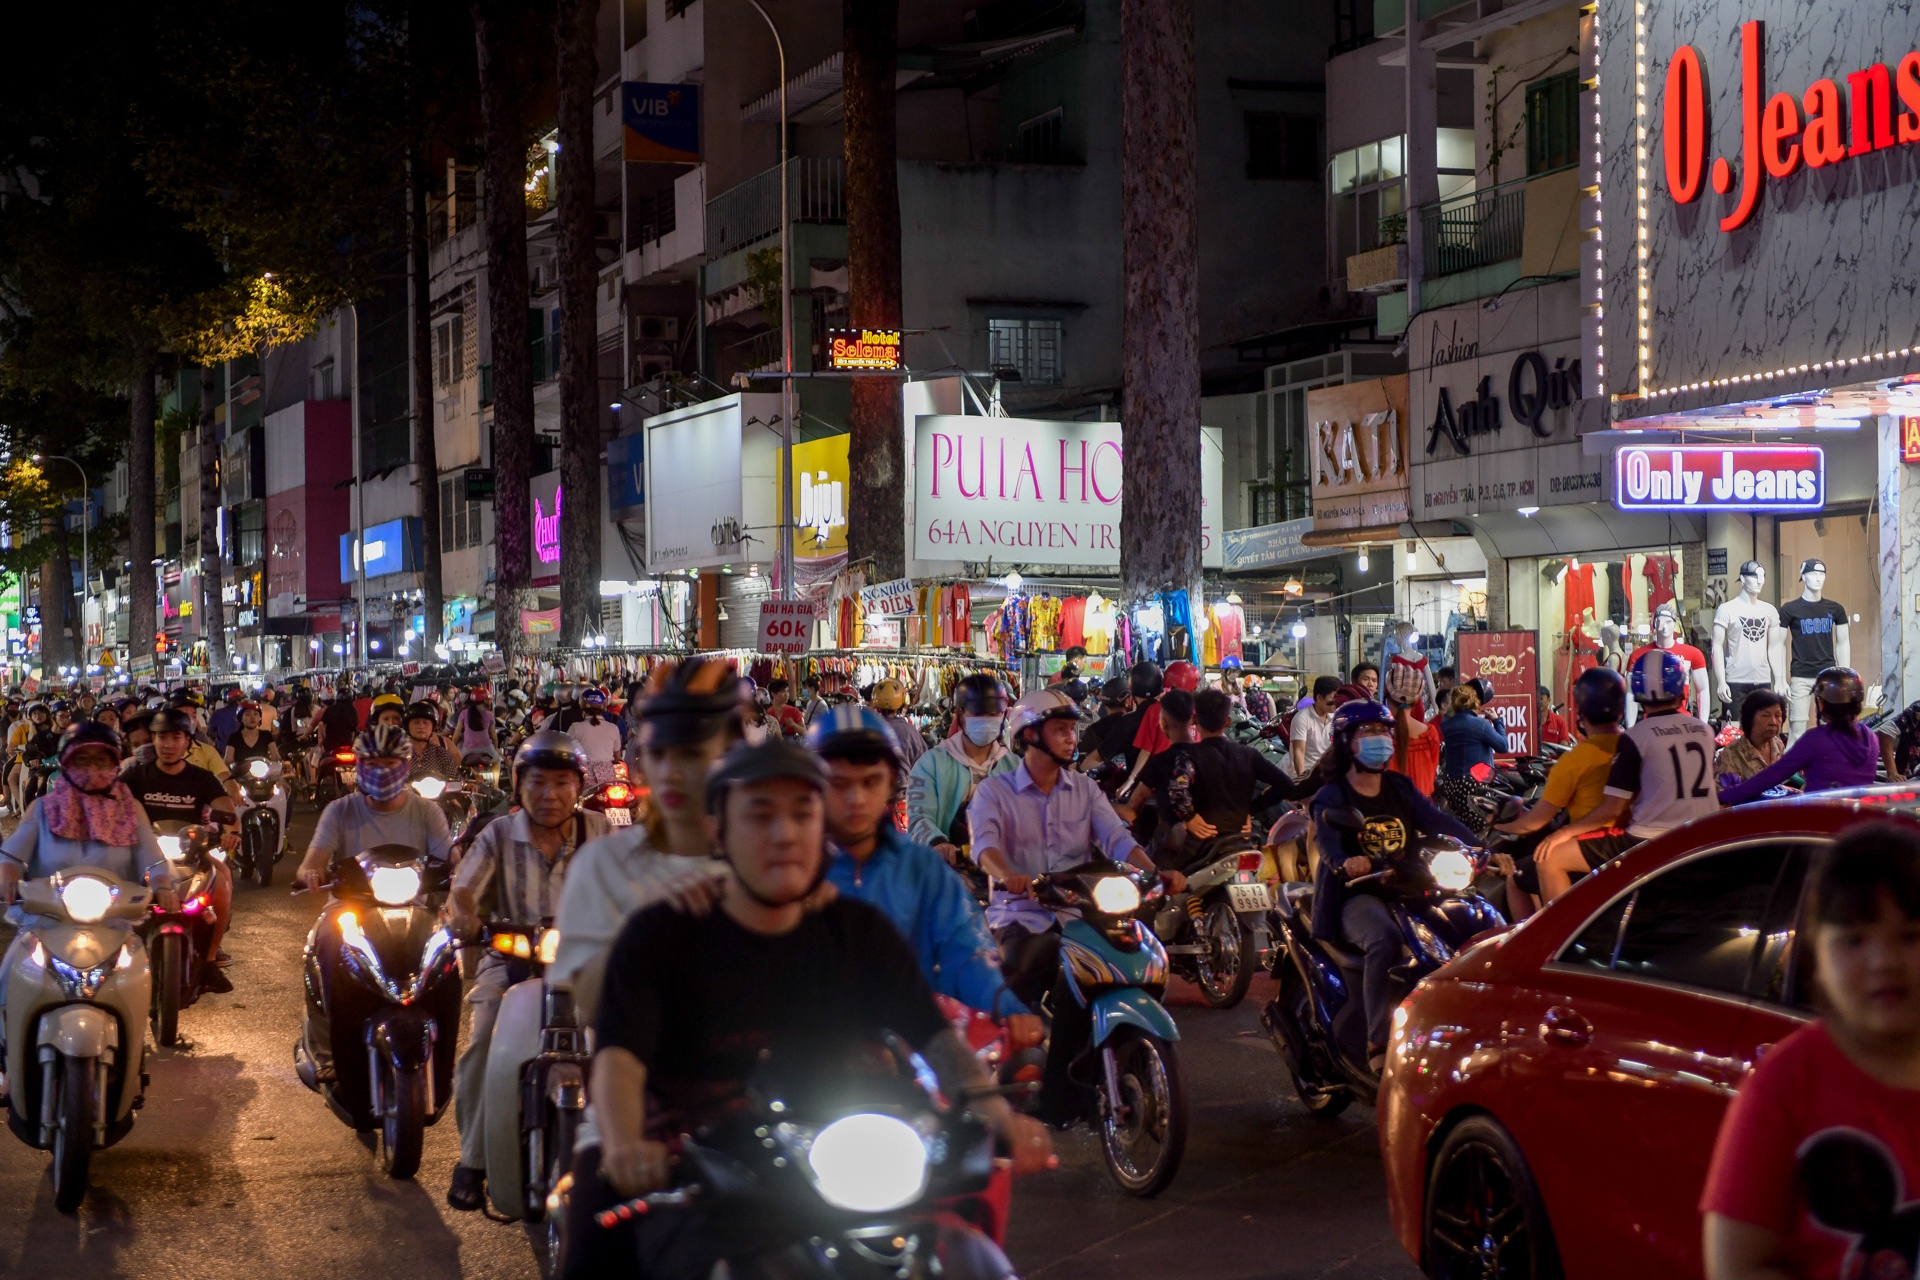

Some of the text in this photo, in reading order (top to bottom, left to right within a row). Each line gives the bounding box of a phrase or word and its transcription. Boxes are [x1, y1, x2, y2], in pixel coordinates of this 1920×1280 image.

[632, 97, 669, 116] VIB
[833, 338, 896, 358] Selena
[862, 331, 898, 345] Hotel
[1430, 319, 1479, 383] fashion
[1426, 375, 1502, 455] Anh
[1314, 407, 1398, 487] KATI
[1626, 450, 1816, 504] Only Jeans
[1520, 480, 1535, 496] HCM
[928, 519, 972, 545] 64A
[979, 520, 1079, 549] NGUYEN
[1085, 524, 1122, 550] TR
[1261, 550, 1276, 561] TÂM
[763, 601, 813, 615] ĐẠI HẠ GIÁ
[403, 662, 419, 675] 50K
[1479, 655, 1517, 675] 2020
[1651, 724, 1682, 737] Thanh
[1508, 732, 1528, 755] 0K
[1669, 741, 1710, 799] 12
[143, 791, 182, 804] adidas
